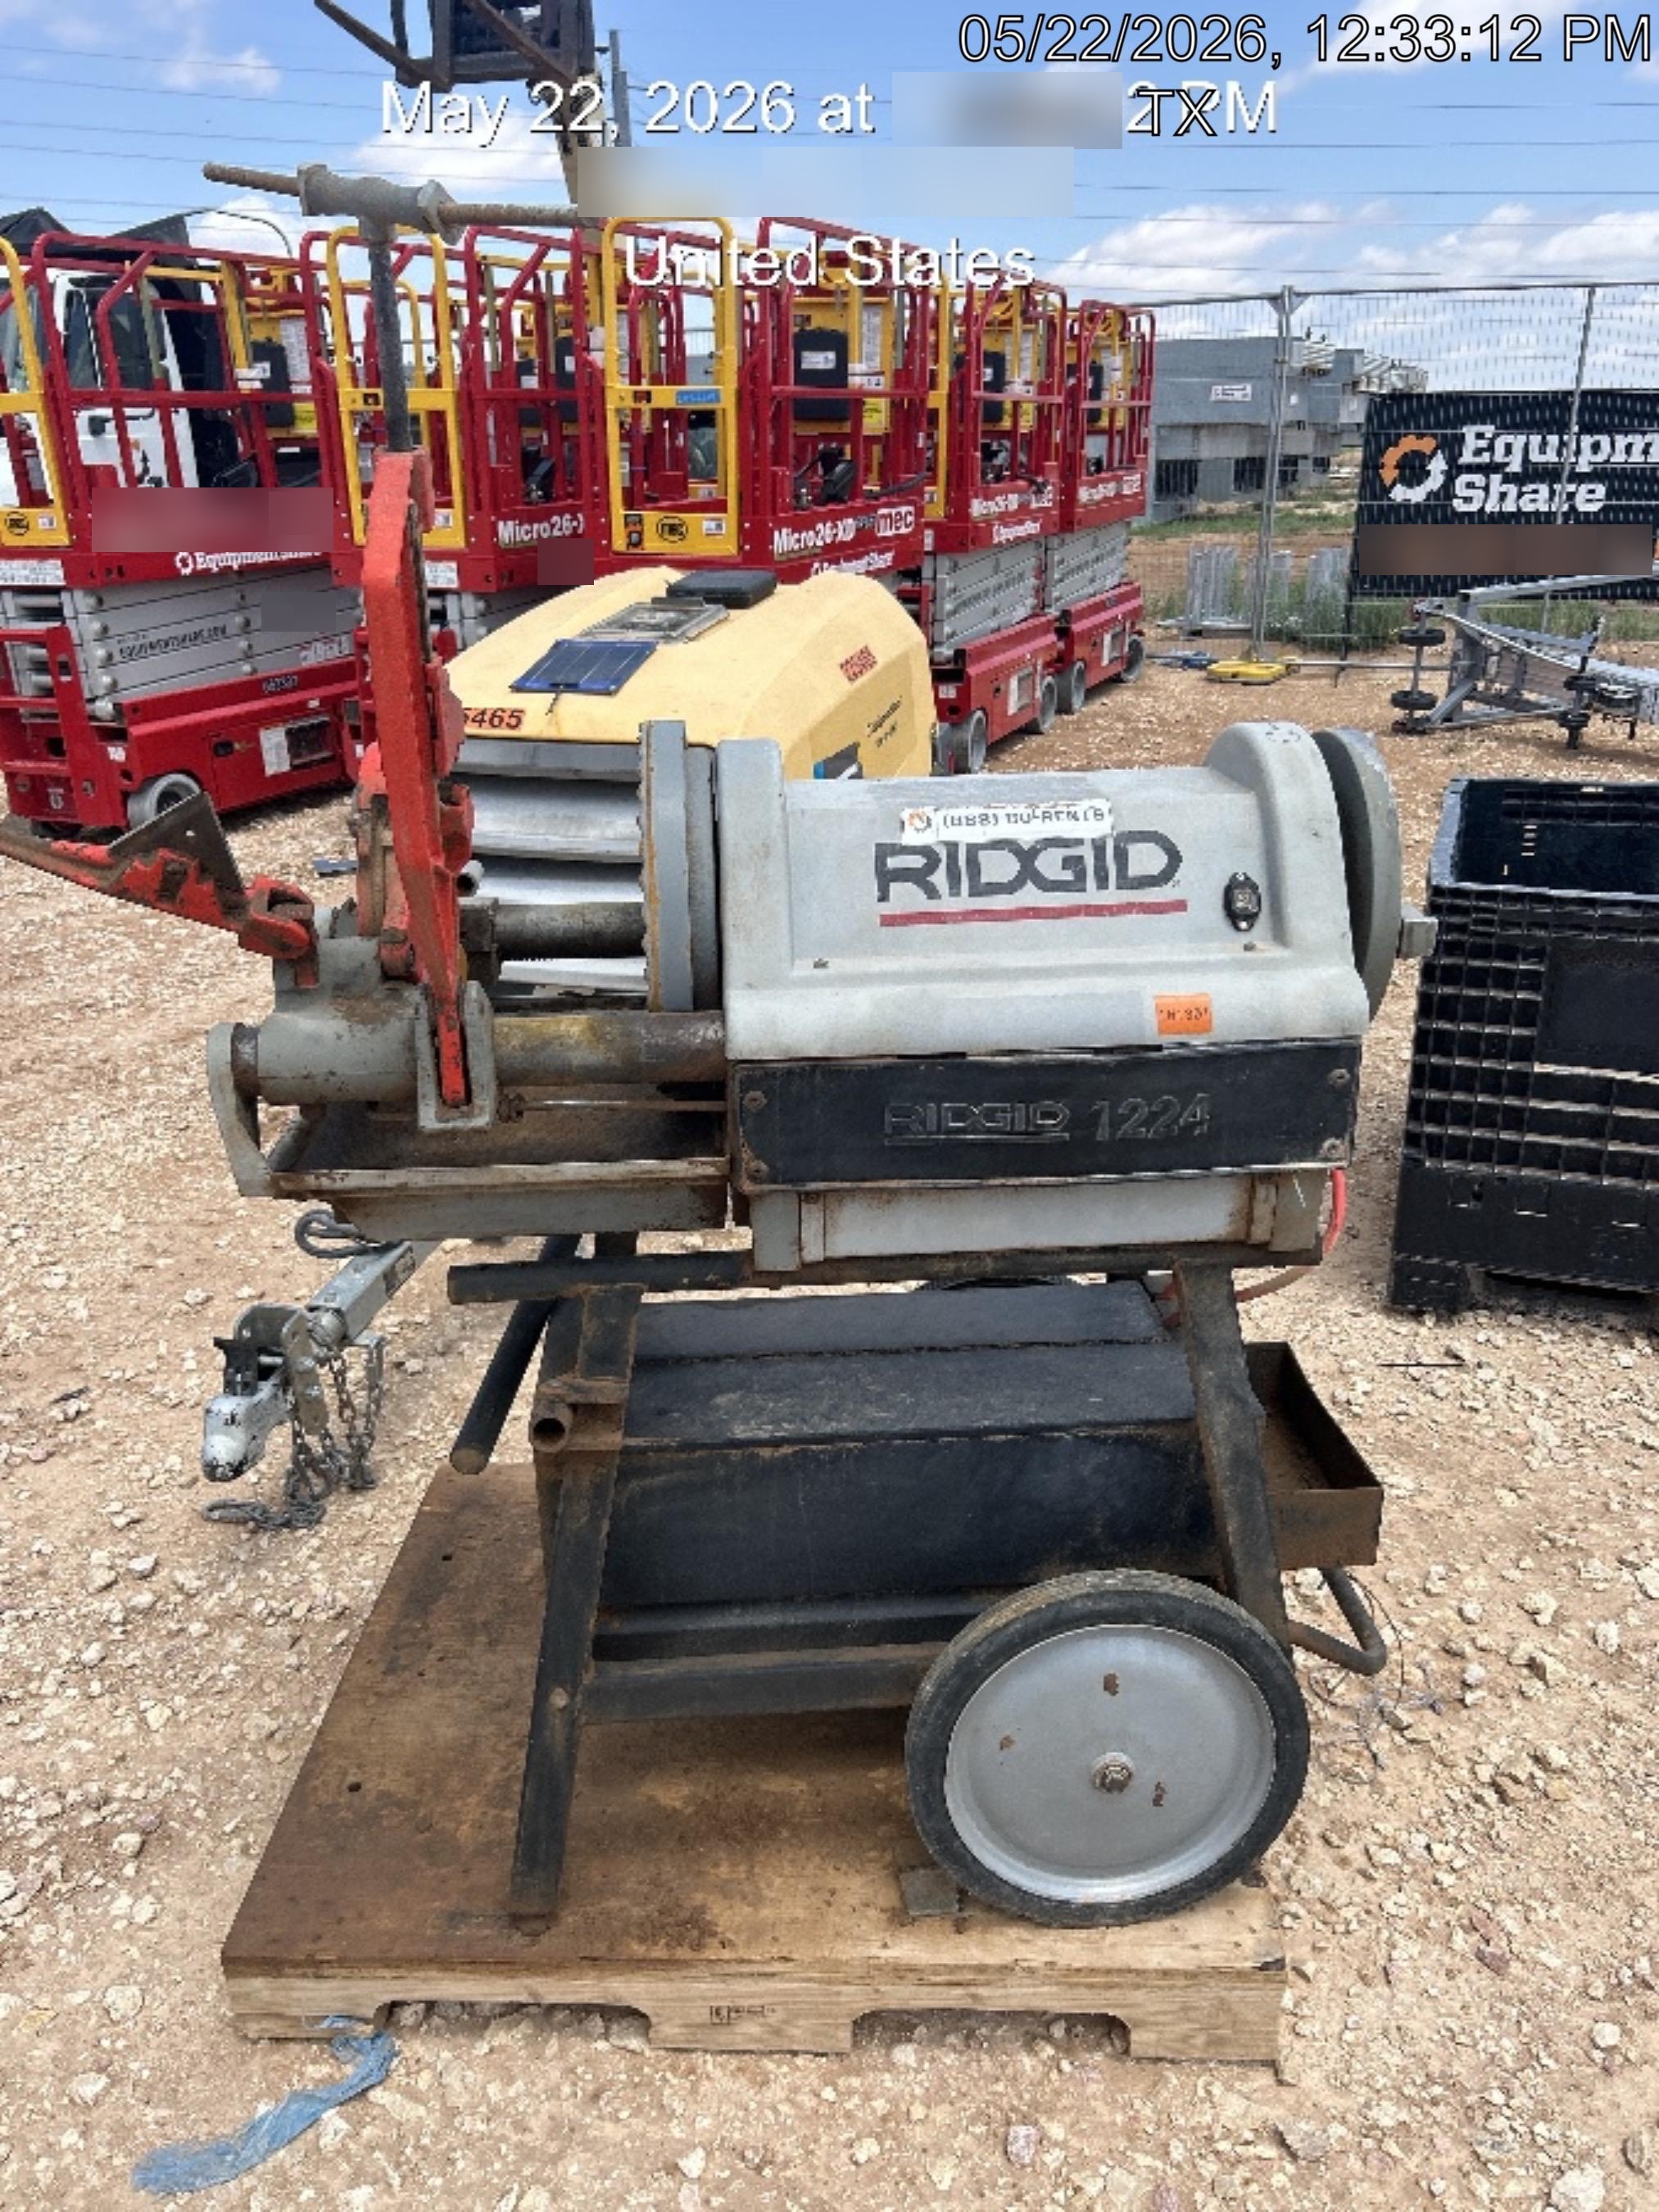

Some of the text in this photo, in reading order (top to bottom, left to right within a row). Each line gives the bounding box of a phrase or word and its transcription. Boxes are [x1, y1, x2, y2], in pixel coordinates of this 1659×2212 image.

[1451, 474, 1607, 514] Share
[877, 508, 914, 536] mec
[875, 831, 1183, 902] RIDGID
[884, 1093, 1212, 1141] RIDGID 1224
